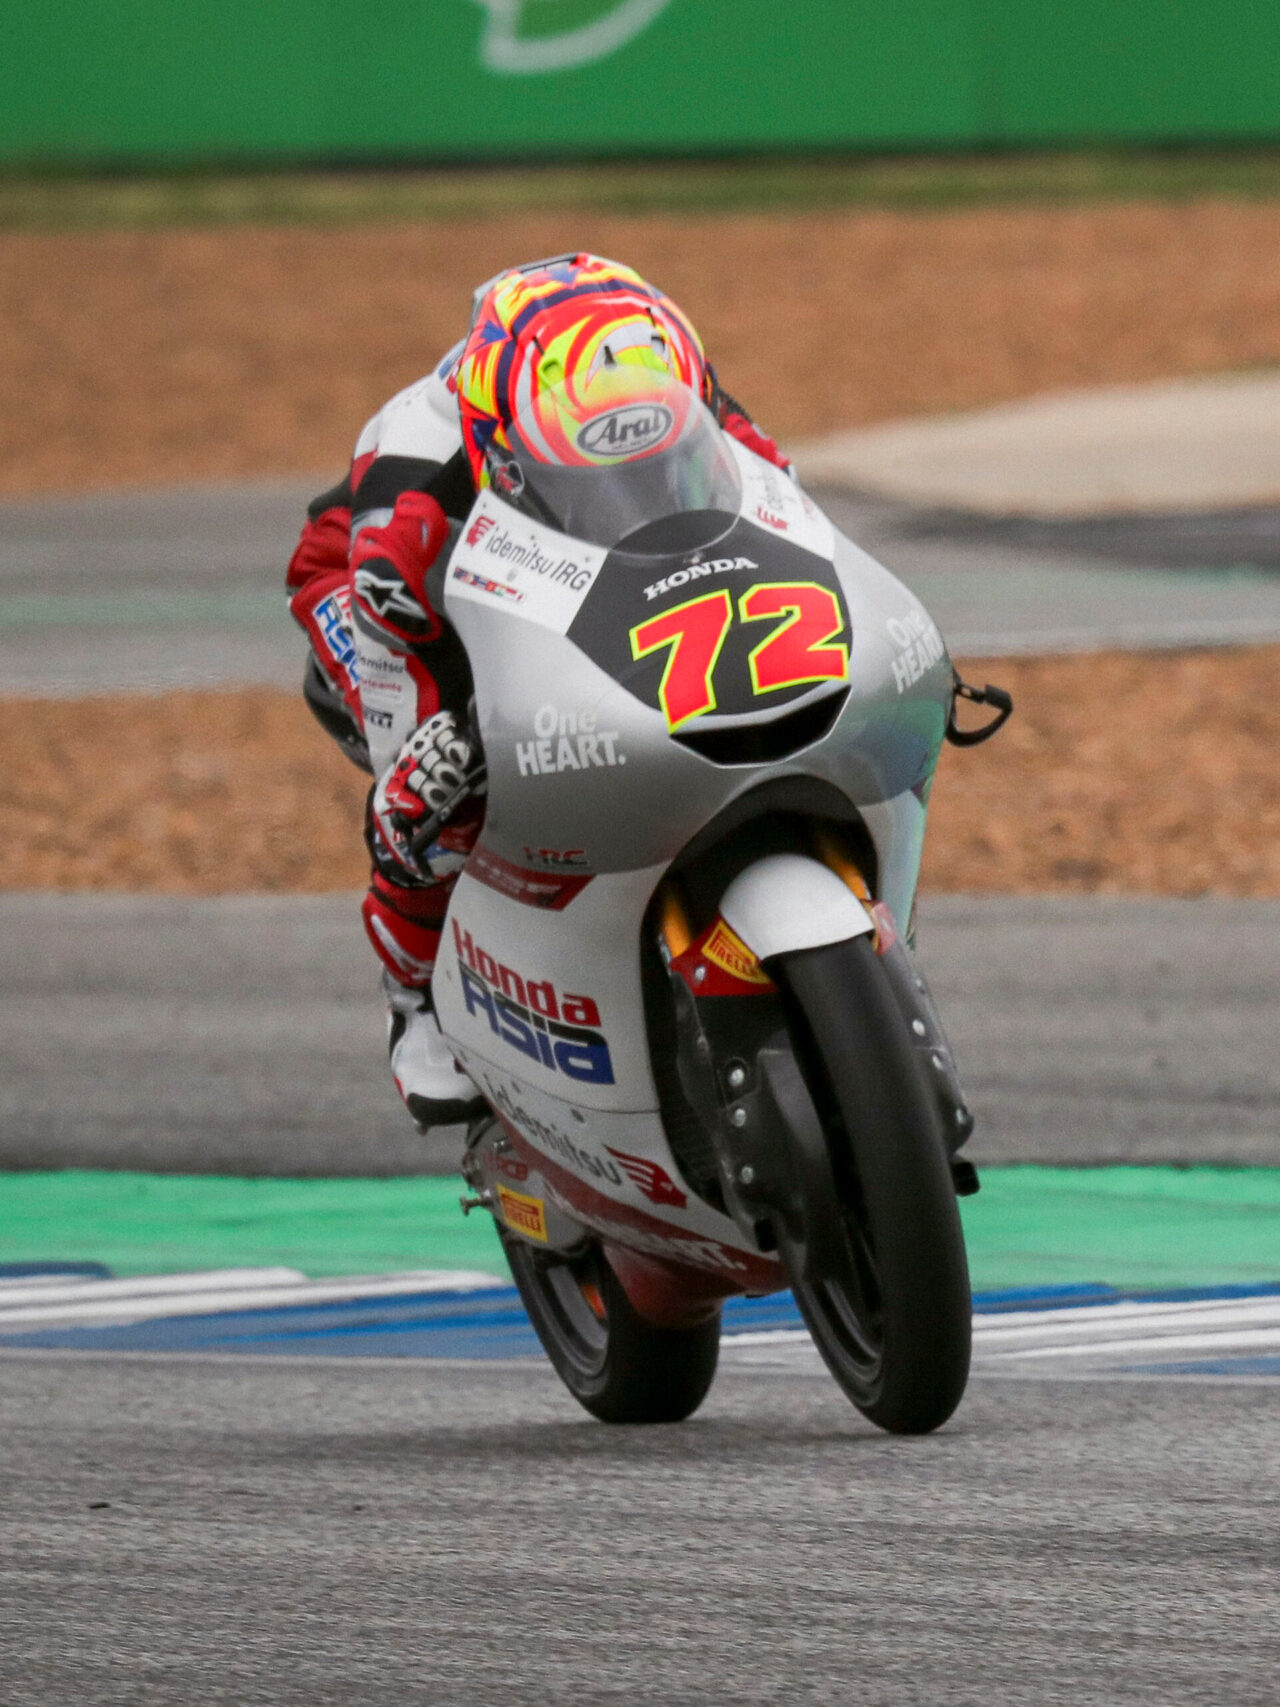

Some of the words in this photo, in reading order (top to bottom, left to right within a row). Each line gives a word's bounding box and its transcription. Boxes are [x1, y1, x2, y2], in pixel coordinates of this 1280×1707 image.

[485, 526, 553, 575] idemitsu
[550, 559, 592, 592] IRG
[642, 556, 759, 600] HONDA
[629, 581, 850, 735] 72
[533, 705, 597, 739] One
[515, 731, 627, 777] HEART.
[451, 917, 602, 1027] Honda
